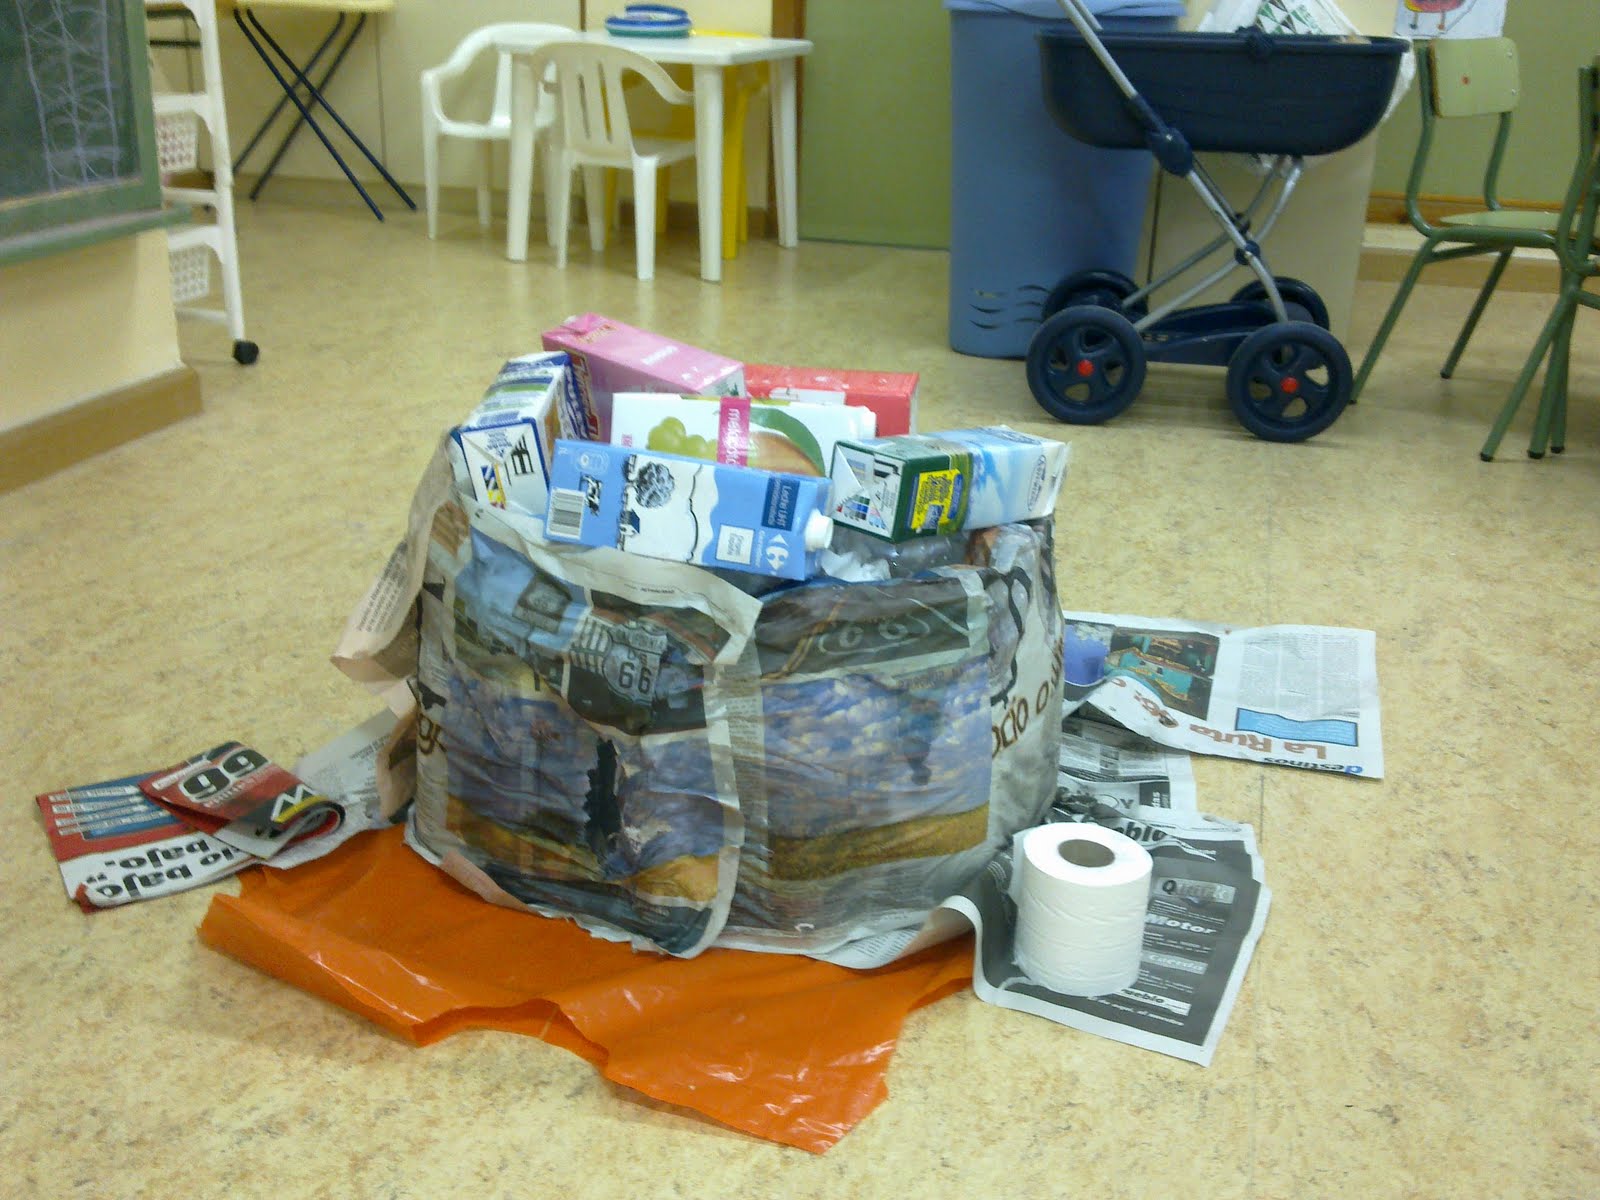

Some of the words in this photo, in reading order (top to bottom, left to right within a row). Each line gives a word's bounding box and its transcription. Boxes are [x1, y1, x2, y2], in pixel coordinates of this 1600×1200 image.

[618, 661, 652, 694] 66
[1188, 723, 1273, 753] Ruta
[1283, 741, 1327, 760] La
[1263, 757, 1363, 775] destinos
[1145, 913, 1217, 935] Motor
